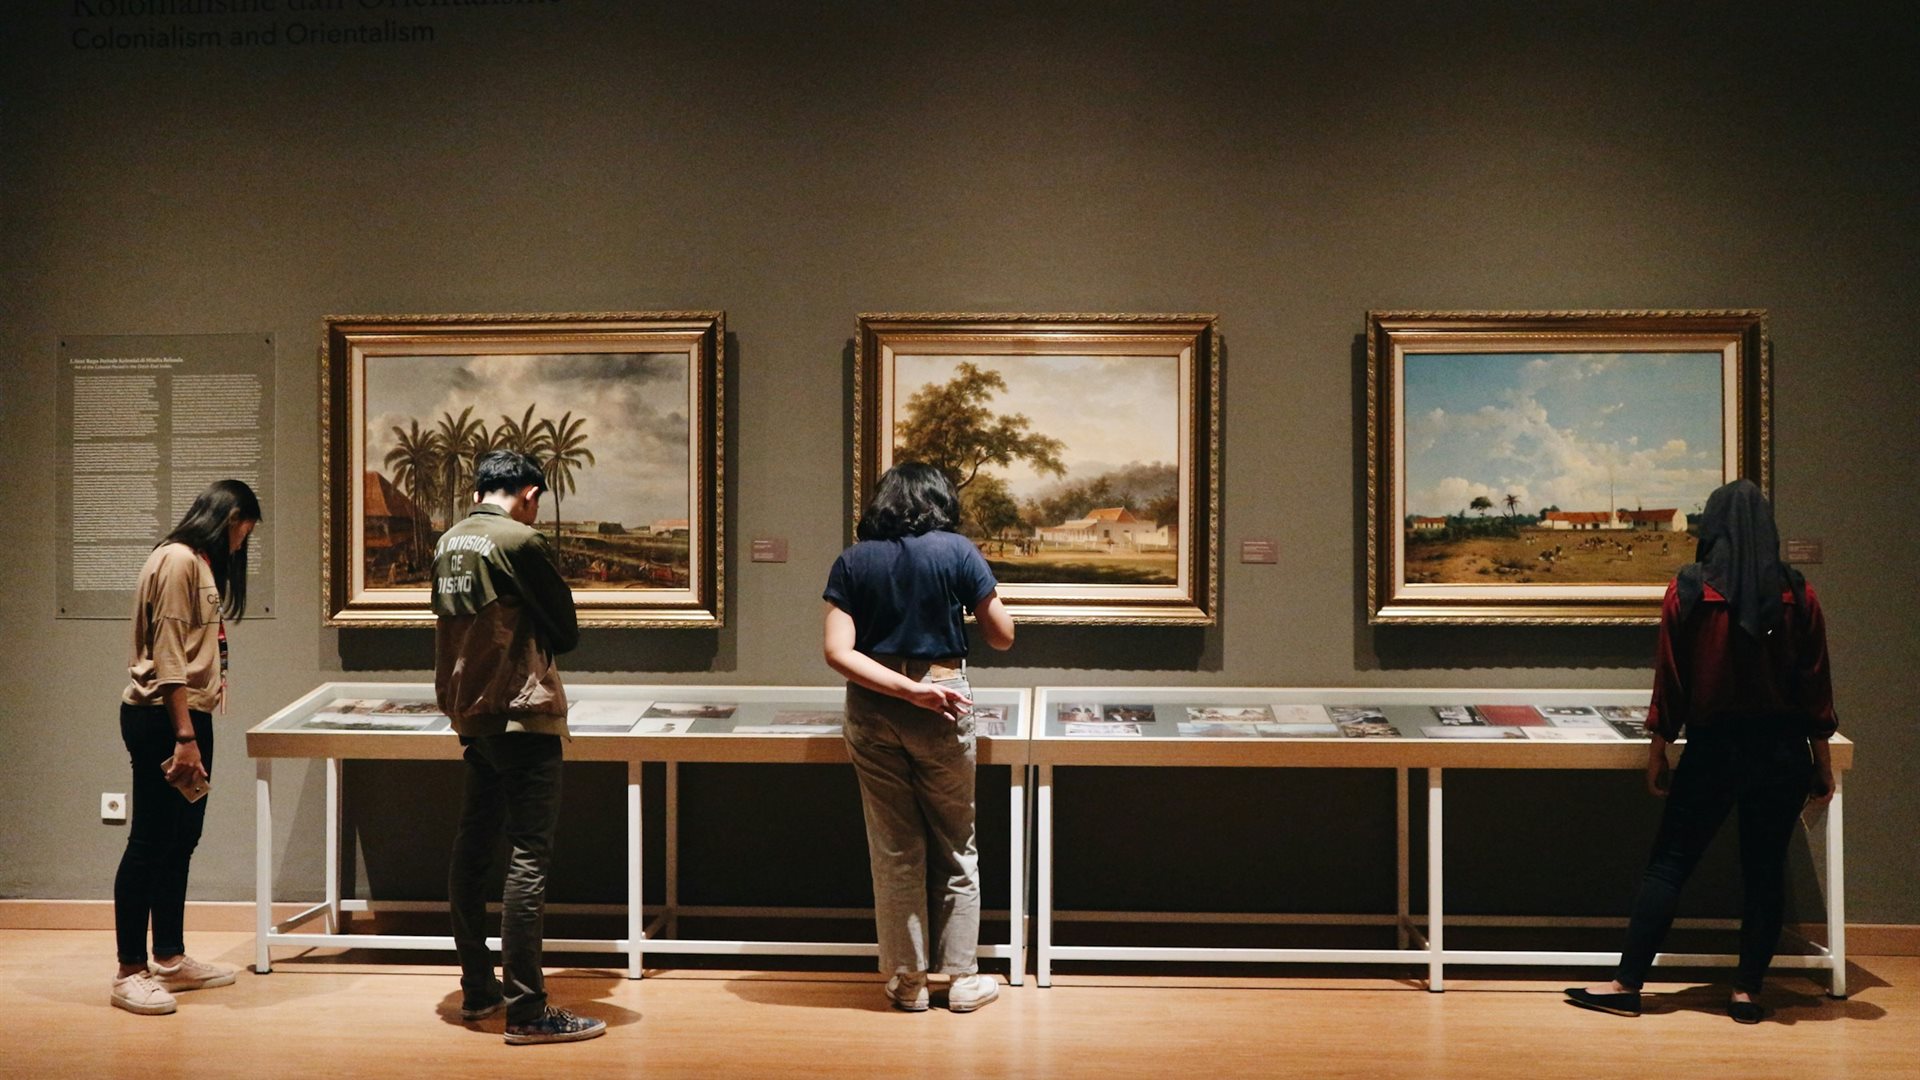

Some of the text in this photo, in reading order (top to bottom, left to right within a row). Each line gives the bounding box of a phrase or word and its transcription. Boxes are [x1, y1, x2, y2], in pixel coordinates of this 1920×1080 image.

[72, 18, 434, 50] Colonialism and Orientalism
[451, 554, 463, 571] DE
